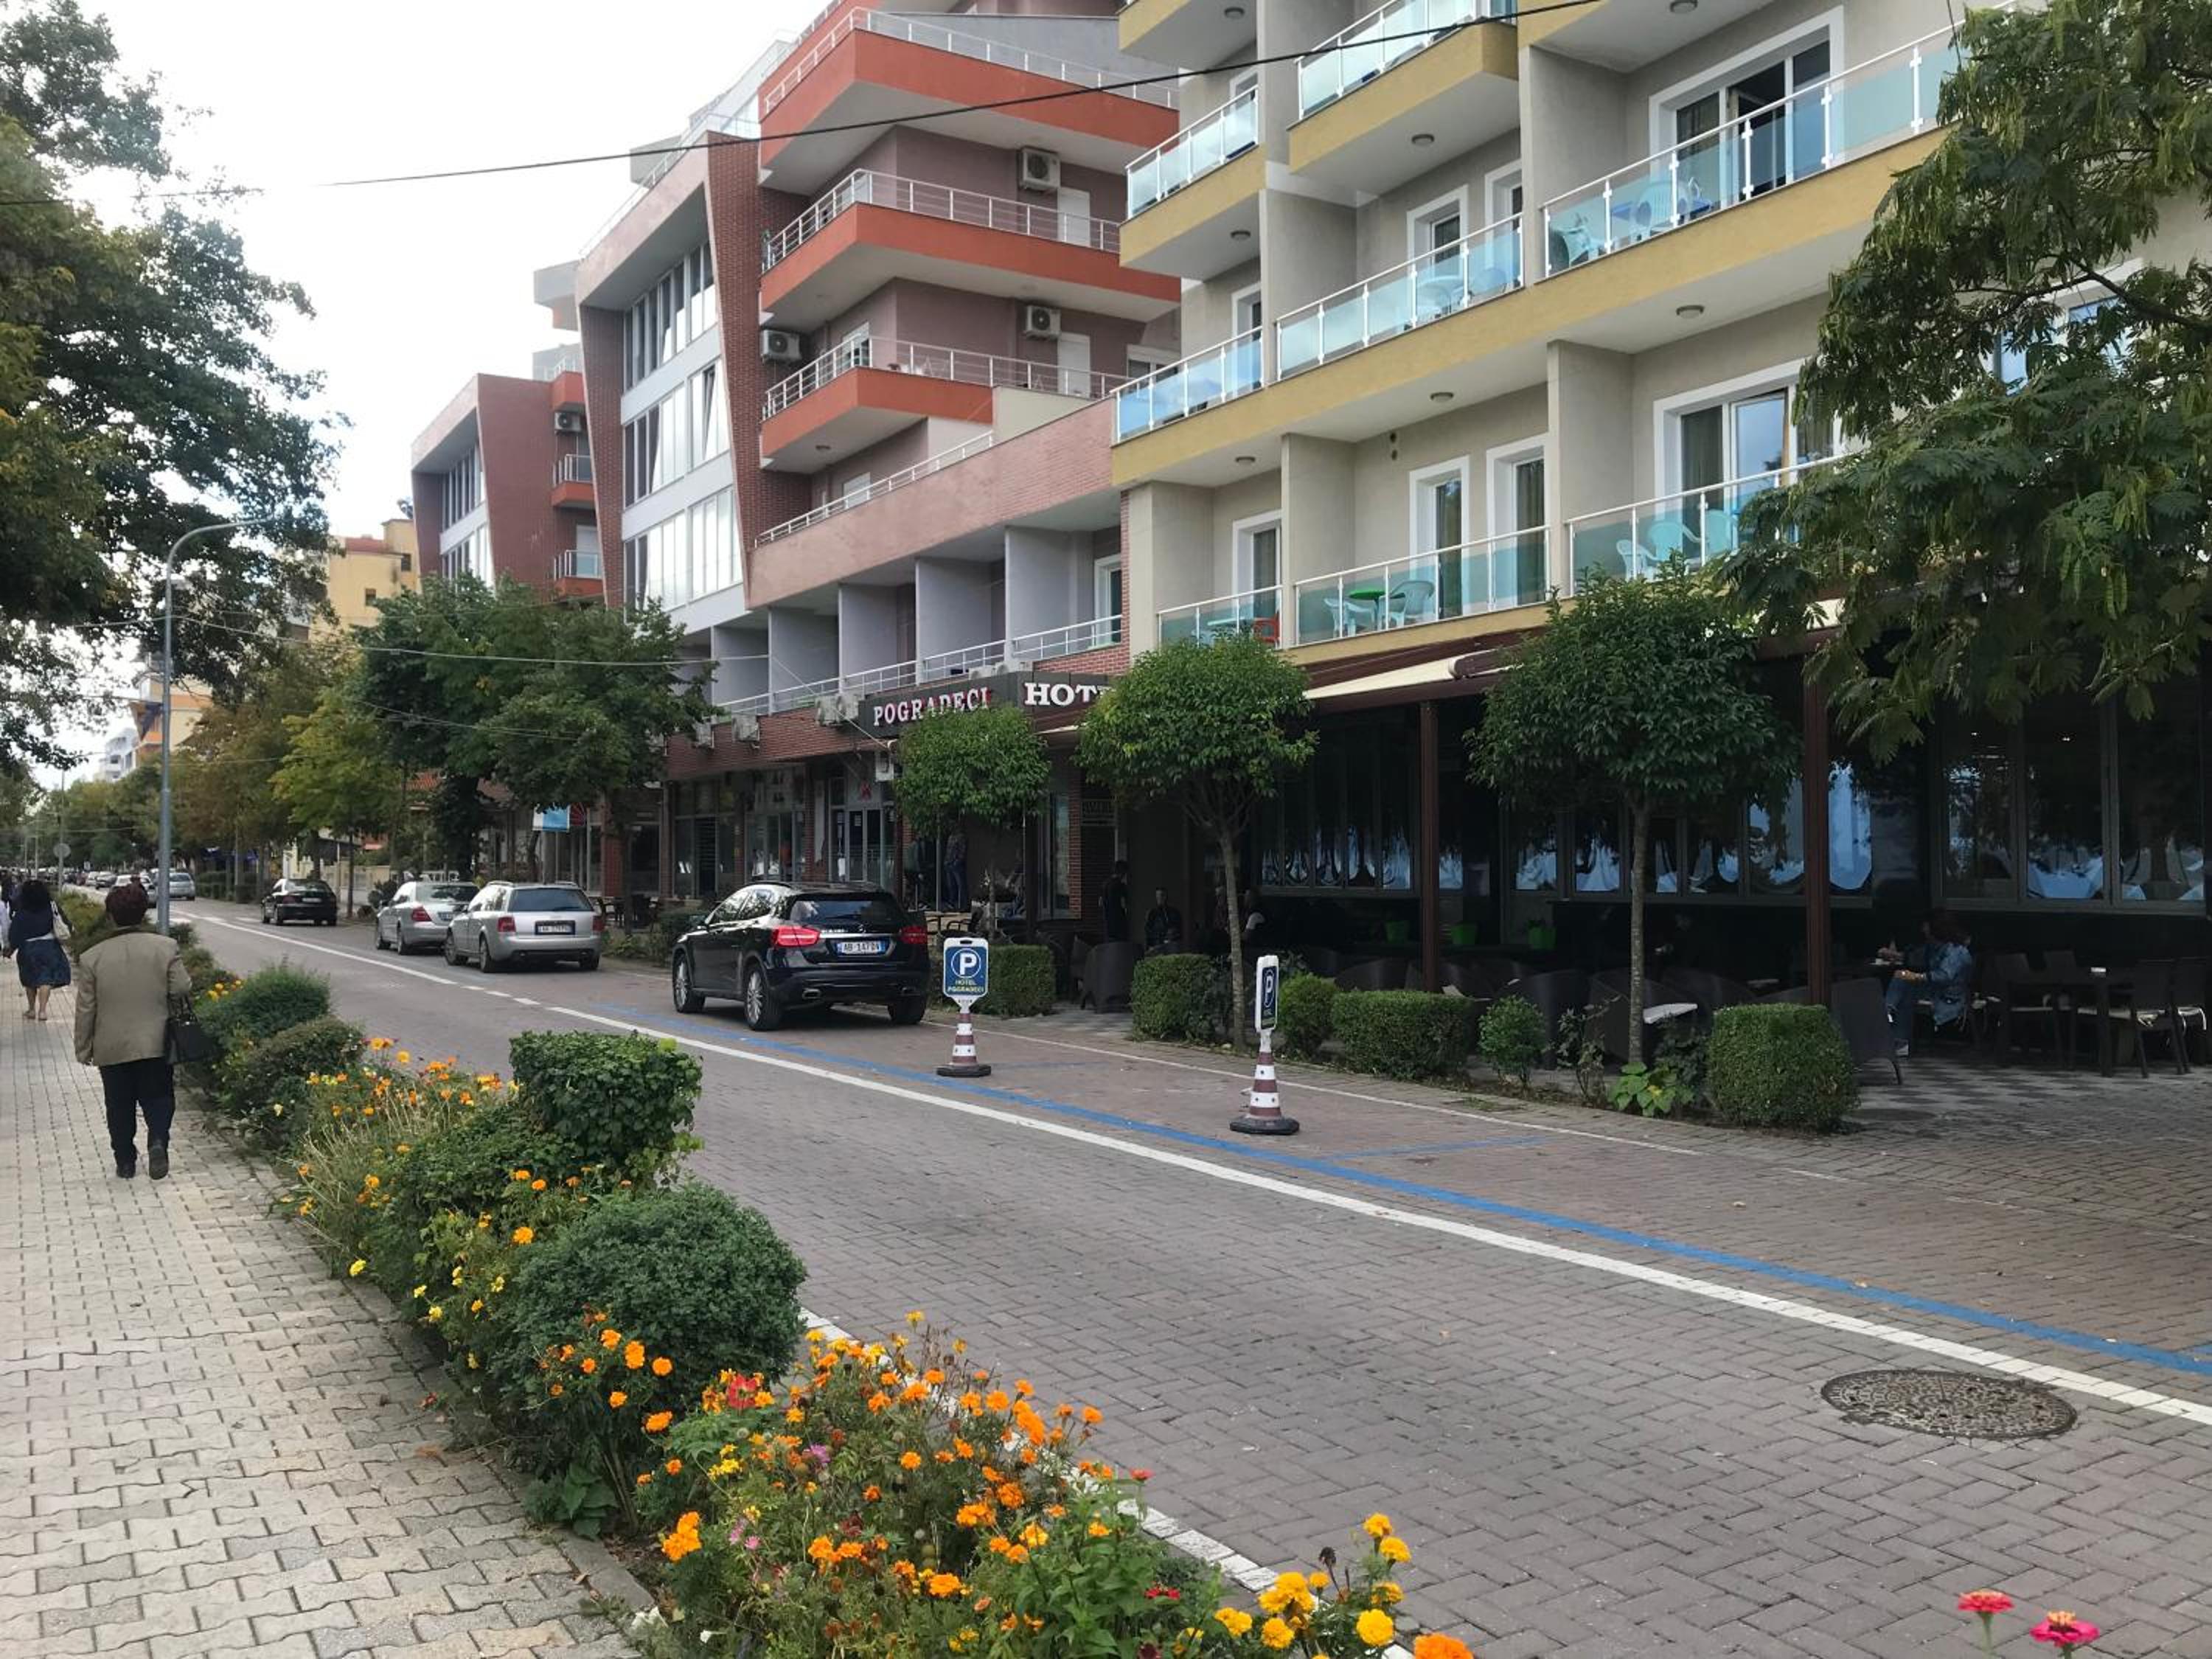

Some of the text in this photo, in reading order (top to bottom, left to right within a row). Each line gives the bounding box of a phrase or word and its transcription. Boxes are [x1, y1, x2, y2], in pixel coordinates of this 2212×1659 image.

[873, 686, 990, 726] POGRADECI
[1023, 682, 1112, 706] HOT
[959, 953, 977, 975] P
[1265, 975, 1273, 1004] P
